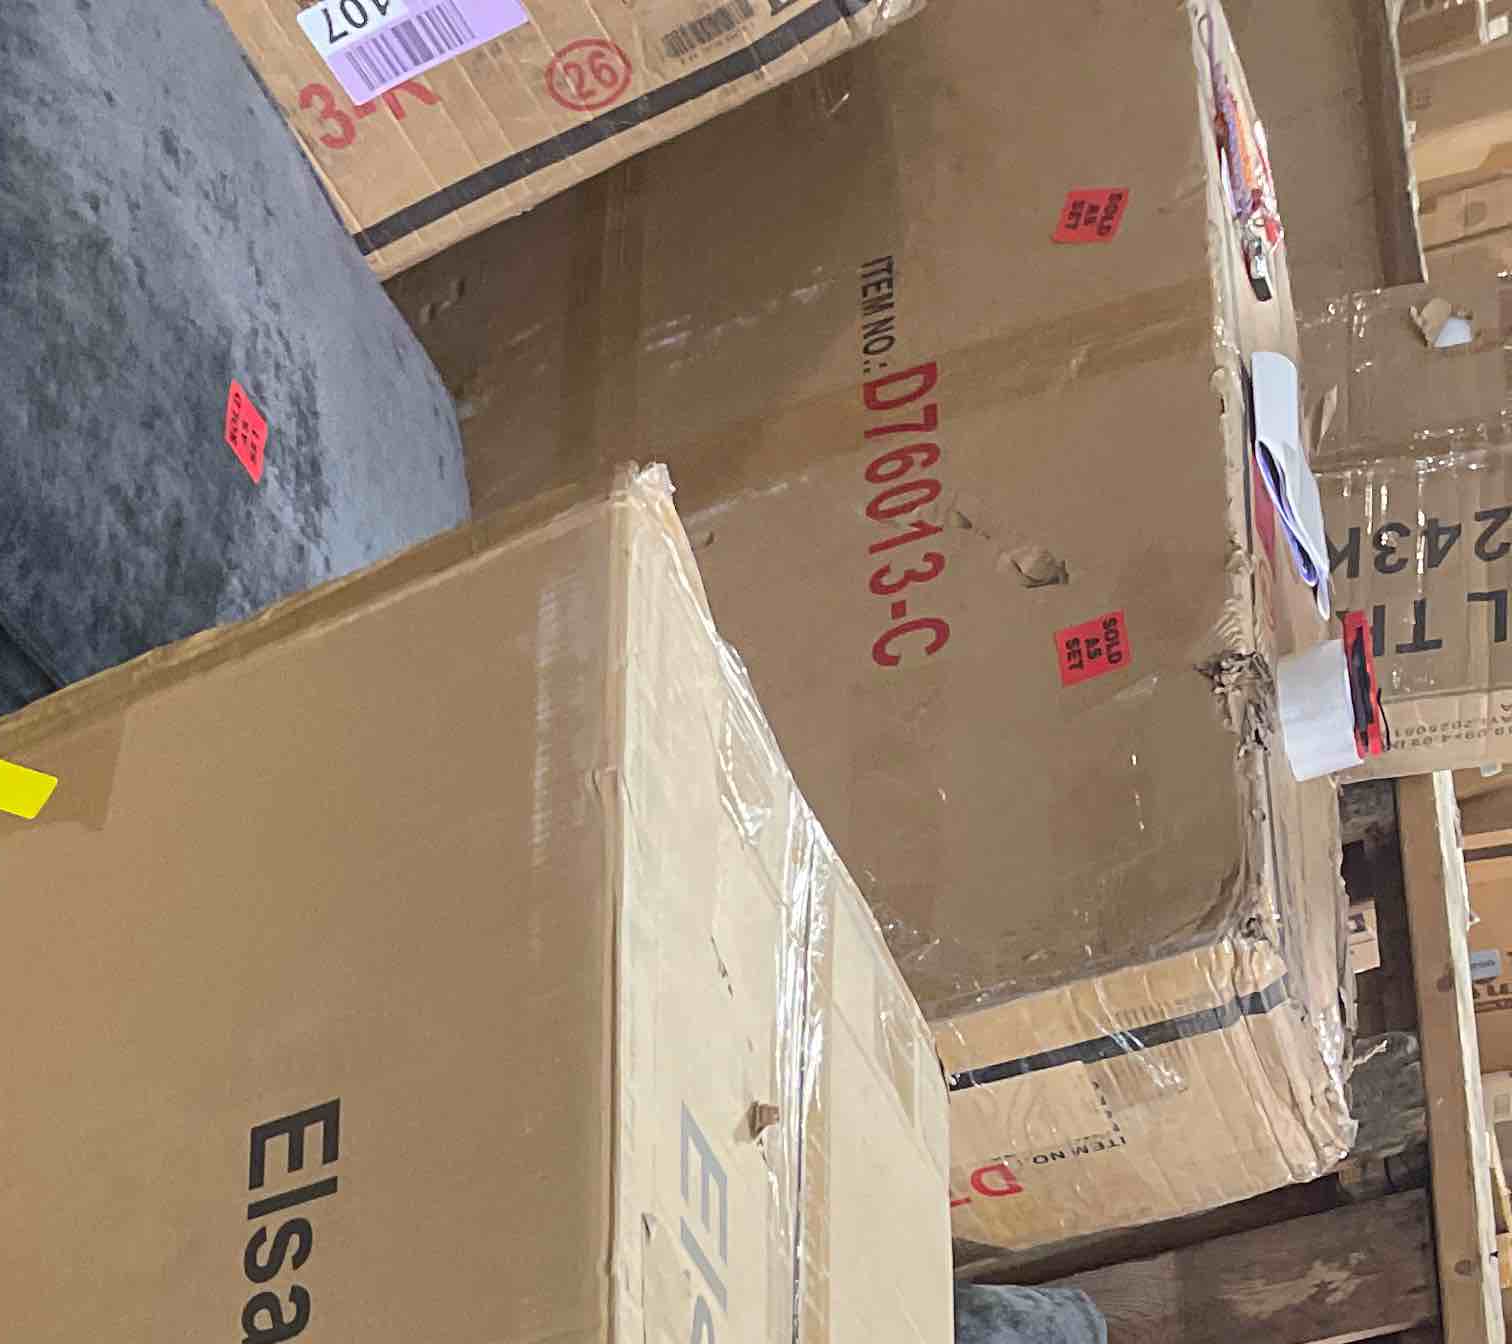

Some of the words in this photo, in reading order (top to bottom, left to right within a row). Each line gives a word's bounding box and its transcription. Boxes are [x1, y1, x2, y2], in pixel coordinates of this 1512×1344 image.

[562, 50, 619, 98] 26
[859, 255, 895, 316] ITEM
[863, 361, 951, 667] D76013-C
[1065, 637, 1084, 671] SET
[1084, 638, 1102, 660] AS
[1102, 617, 1123, 665] SOLD
[1071, 1136, 1127, 1157] ITEM
